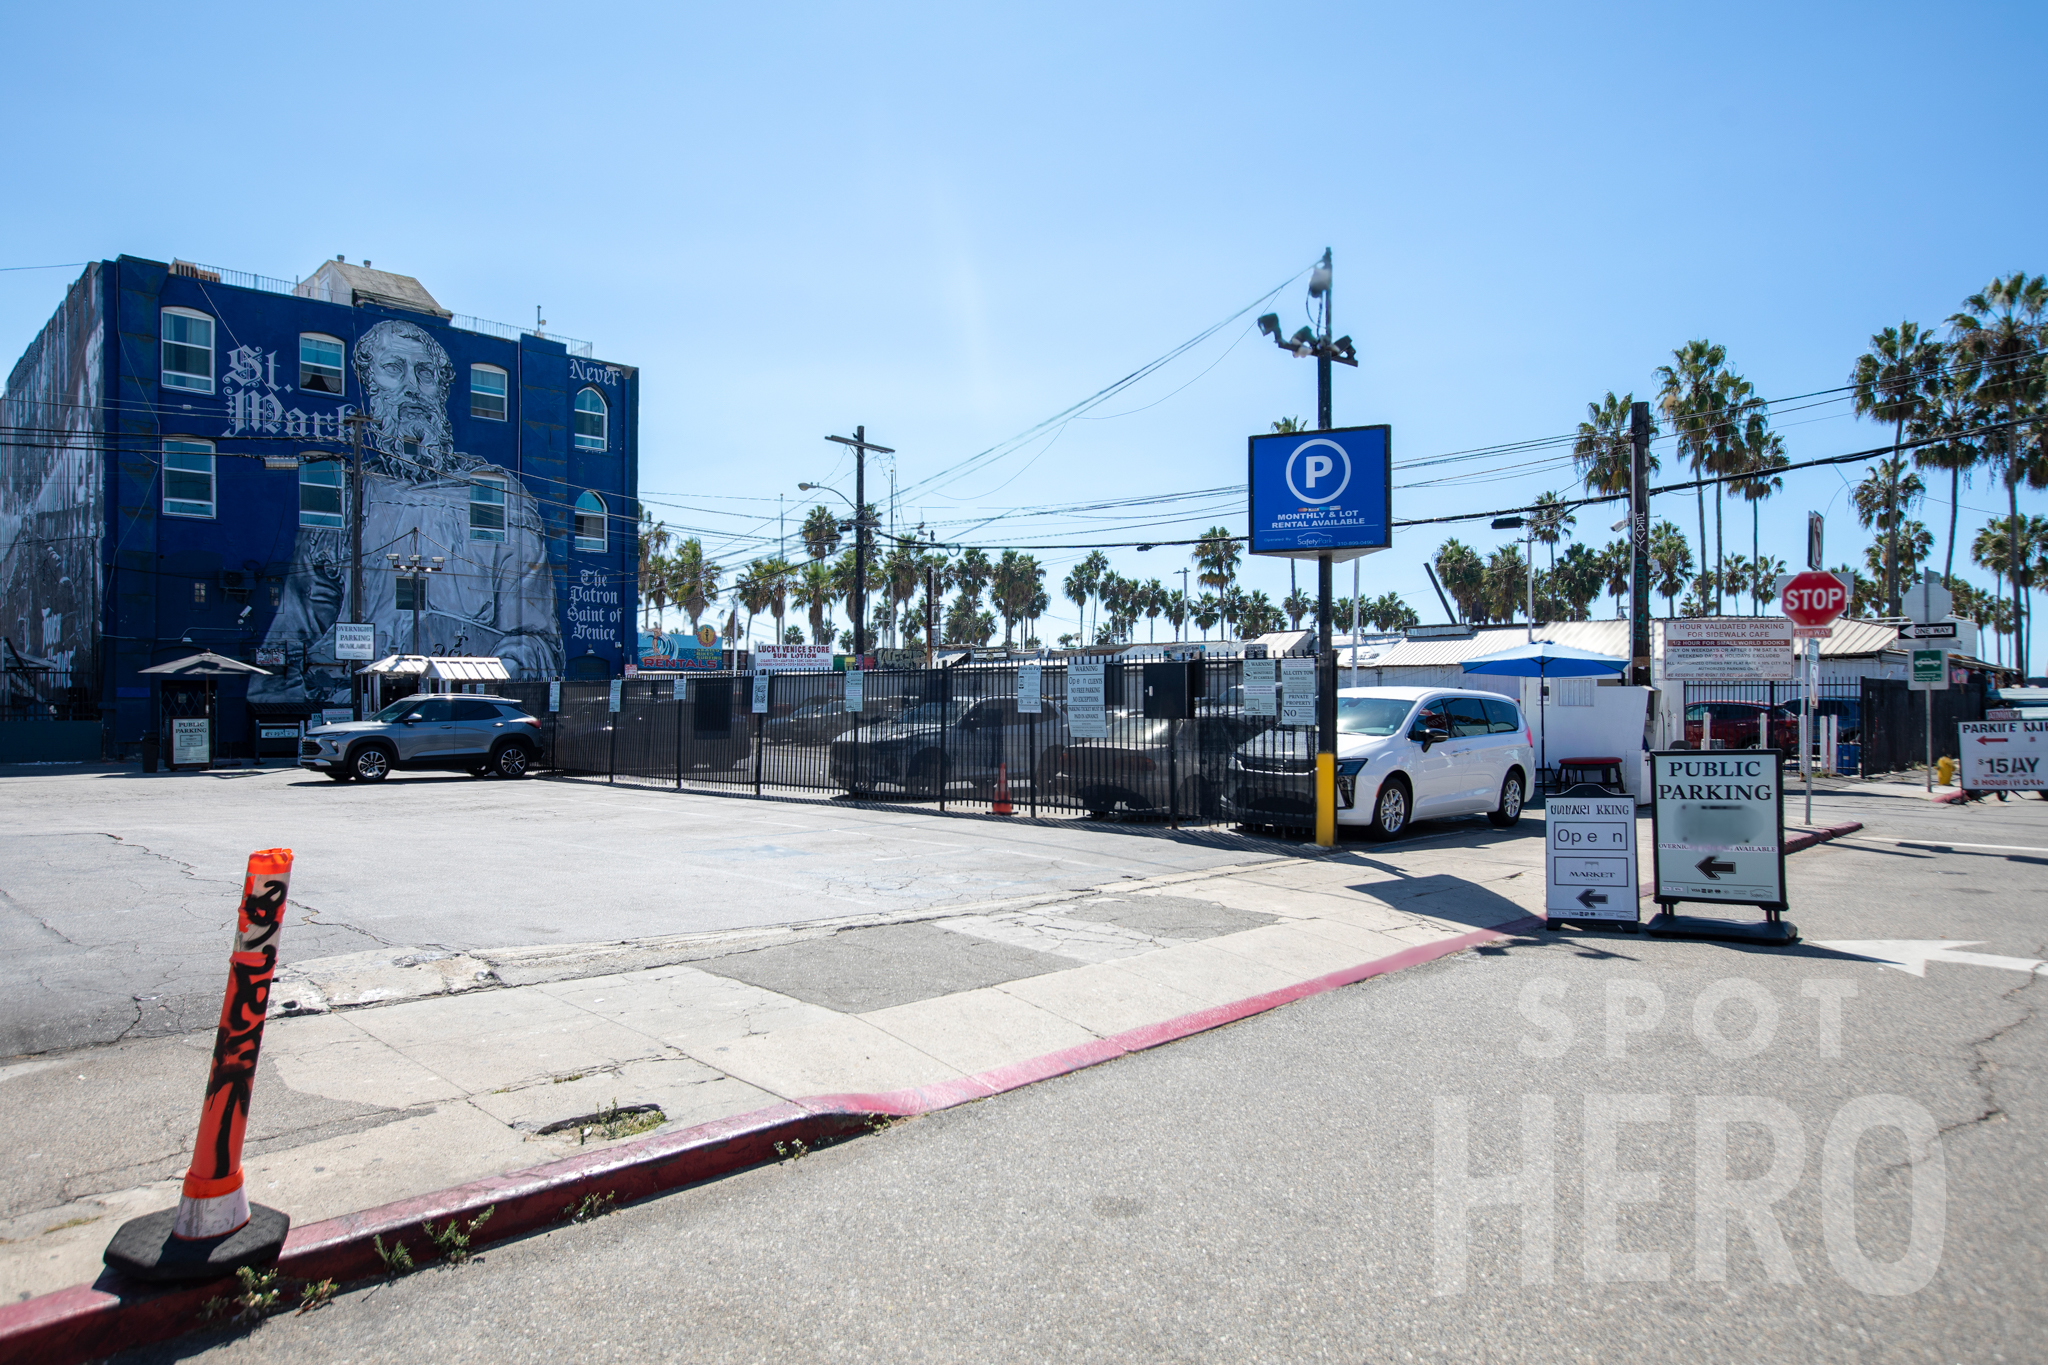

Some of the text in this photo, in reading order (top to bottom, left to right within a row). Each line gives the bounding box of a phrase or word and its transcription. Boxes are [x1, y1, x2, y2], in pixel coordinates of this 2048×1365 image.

[222, 344, 294, 392] St.
[569, 358, 620, 386] Never
[1305, 455, 1334, 489] P
[1271, 517, 1365, 529] RENTAL AVAILABLE
[1277, 509, 1359, 521] MONTHLY & LOT
[1297, 537, 1333, 546] SafetyPark
[580, 568, 608, 588] The
[568, 585, 618, 605] Patron
[1785, 588, 1843, 611] STOP
[567, 603, 624, 623] Saint of
[571, 620, 616, 641] Venice
[1914, 626, 1950, 635] ONE WAY
[757, 645, 780, 653] LUCKY
[782, 645, 806, 653] VENICE
[643, 658, 717, 668] RENTALS
[1283, 709, 1297, 717] NO
[1668, 761, 1761, 777] PUBLIC
[1658, 784, 1772, 800] PARKING
